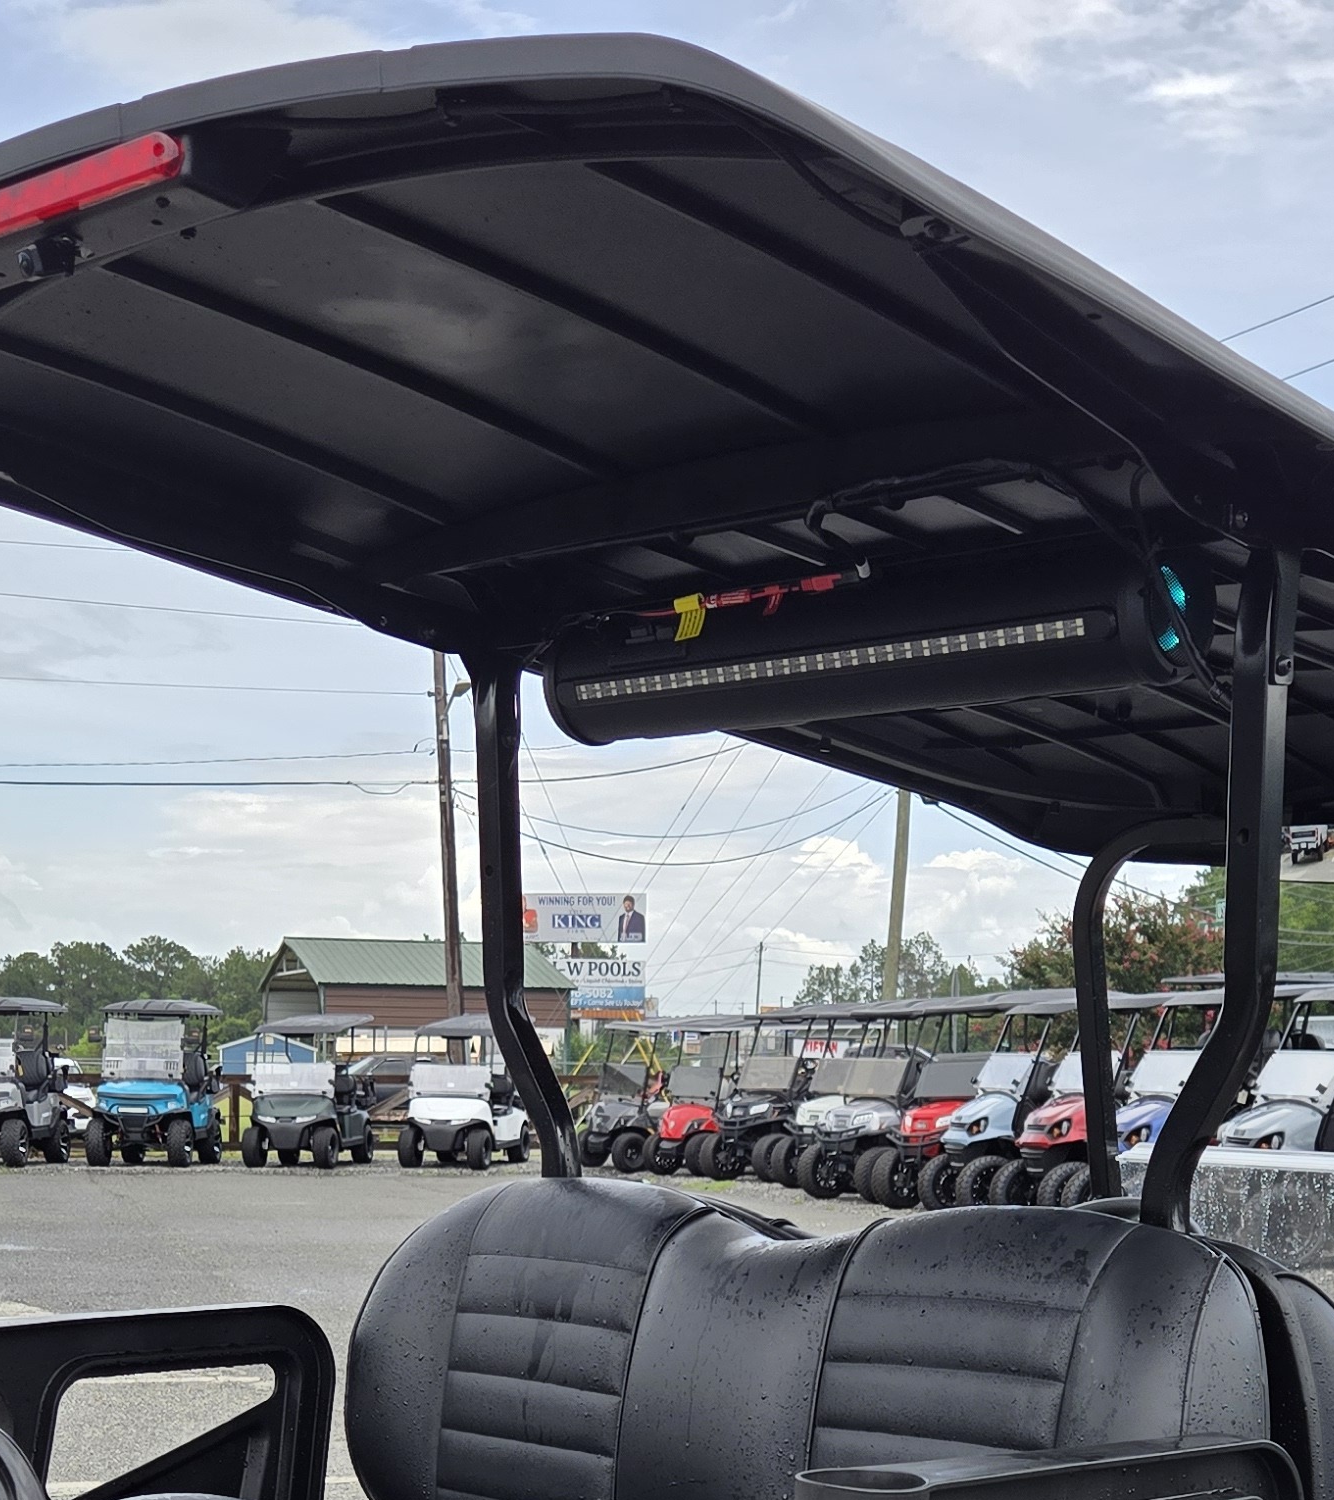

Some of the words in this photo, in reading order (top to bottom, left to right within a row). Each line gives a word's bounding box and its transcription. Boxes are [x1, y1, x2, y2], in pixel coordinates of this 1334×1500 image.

[538, 896, 575, 906] WINNING
[577, 896, 593, 906] FOR
[597, 896, 616, 906] YOU!
[554, 915, 600, 928] KING
[588, 961, 641, 977] POOLS
[805, 1040, 838, 1053] TIFTN
